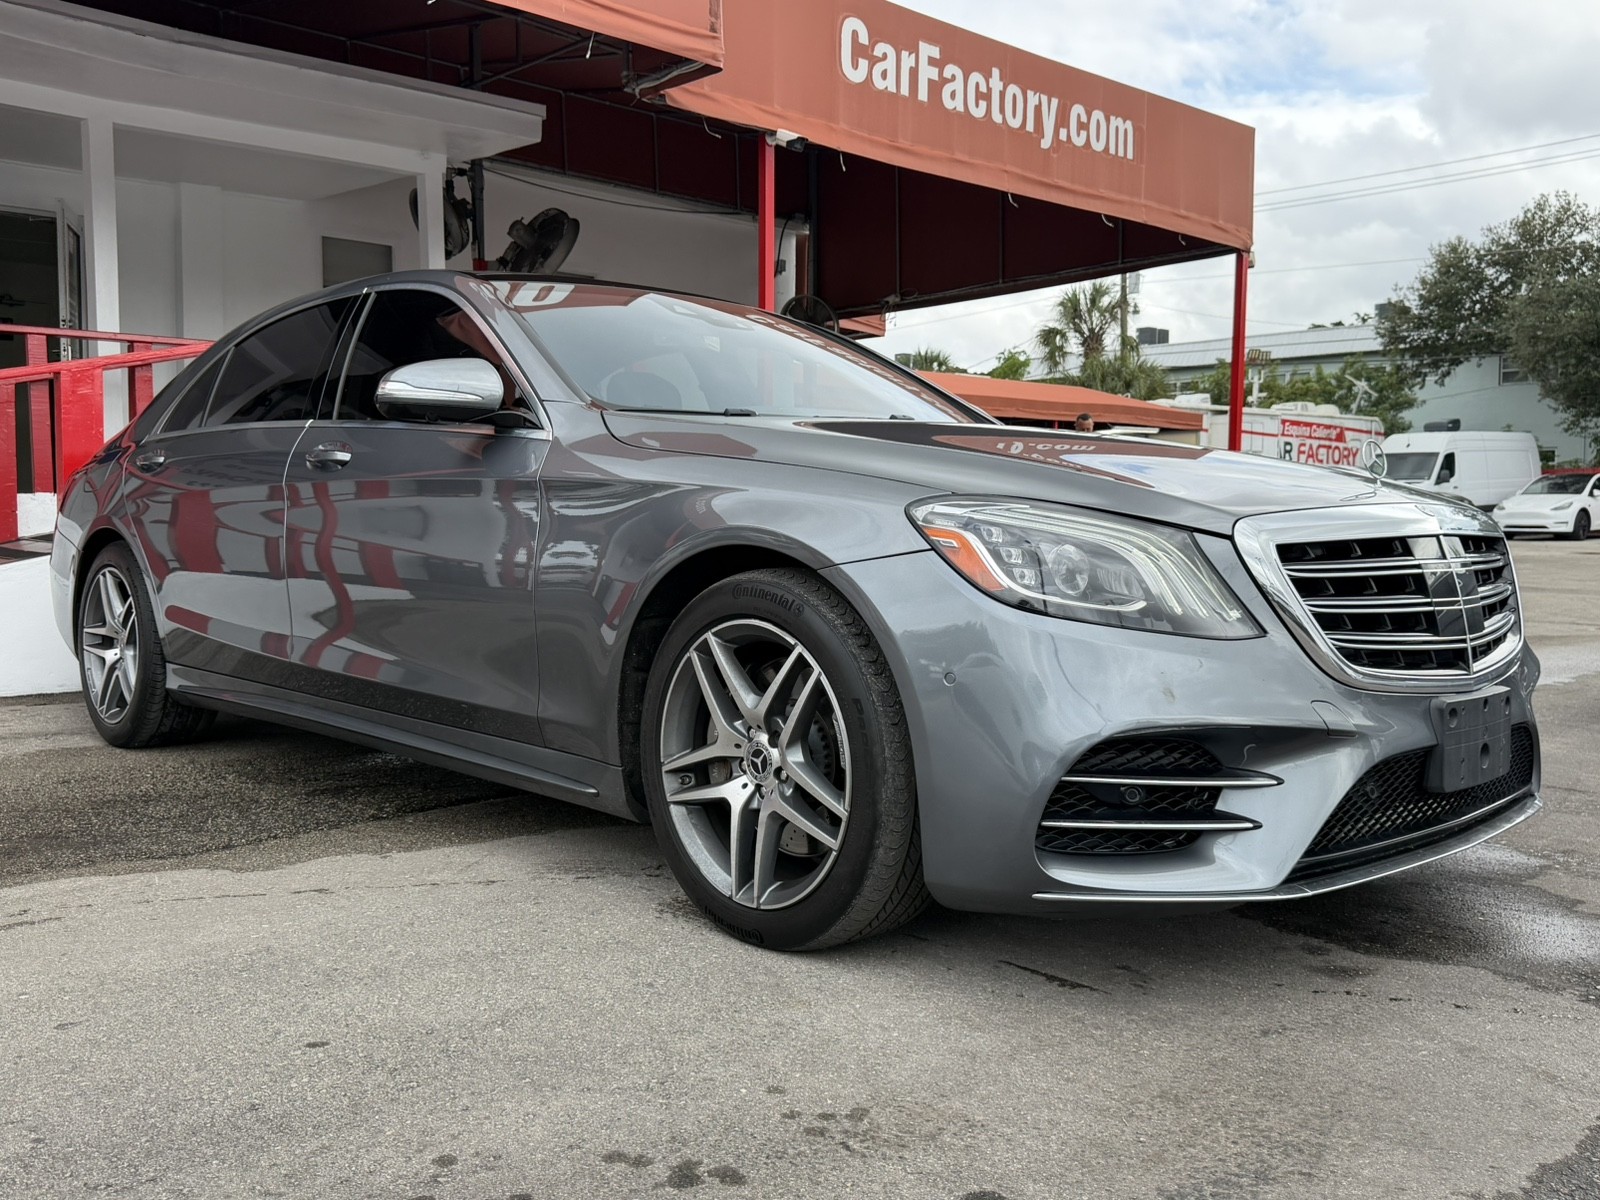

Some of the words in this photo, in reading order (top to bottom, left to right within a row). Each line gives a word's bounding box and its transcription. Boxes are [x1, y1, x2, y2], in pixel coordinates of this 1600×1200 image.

[840, 16, 1134, 160] CarFactory.com
[1297, 443, 1359, 466] FACTORY
[732, 583, 795, 612] Continental
